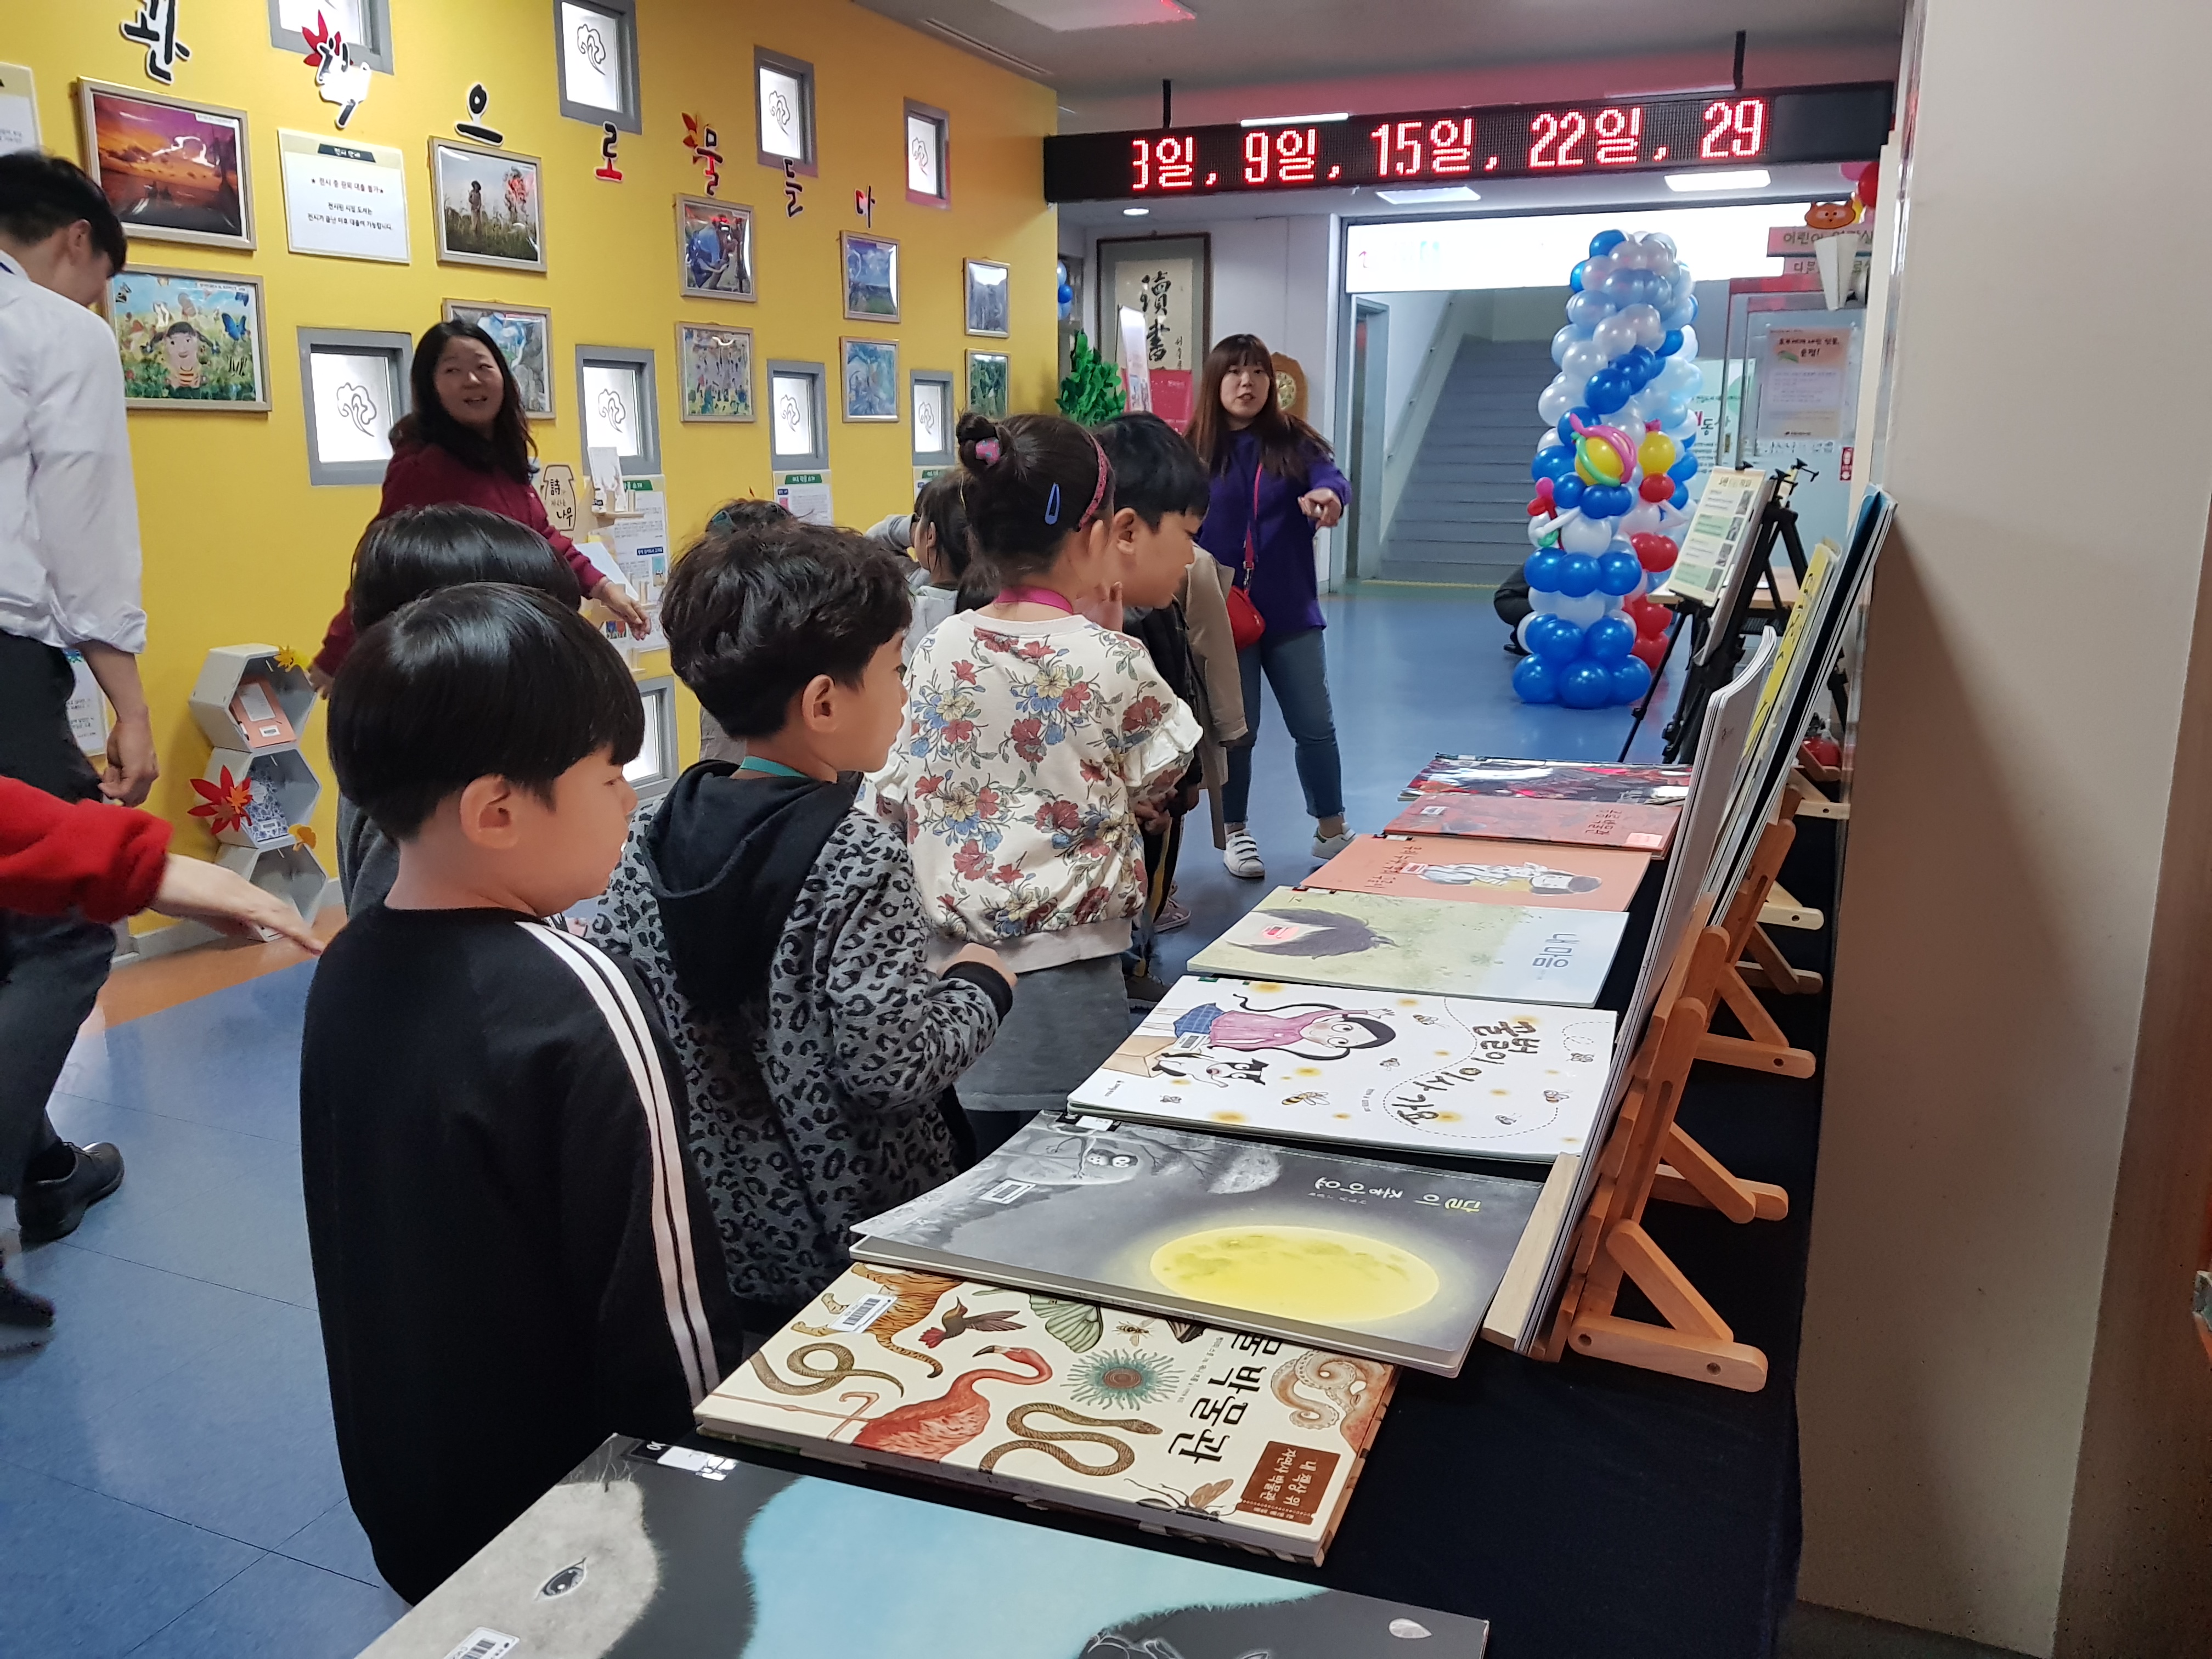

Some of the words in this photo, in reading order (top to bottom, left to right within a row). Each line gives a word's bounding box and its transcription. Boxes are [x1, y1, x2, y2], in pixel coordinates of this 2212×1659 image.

[1244, 128, 1341, 183] 9일,
[1371, 117, 1497, 177] 15일,
[1528, 106, 1668, 168] 22일,
[1701, 98, 1765, 159] 29
[1532, 946, 1573, 968] 마음
[1471, 1020, 1542, 1065] 꿀벌이
[1412, 1068, 1483, 1091] 이사
[1391, 1094, 1440, 1125] 가요
[1314, 1176, 1403, 1199] 좋아요
[1413, 1193, 1481, 1213] 달이
[1168, 1365, 1267, 1464] 박물관
[1274, 1448, 1297, 1474] 자연사
[1299, 1460, 1317, 1472] 내
[1260, 1474, 1285, 1503] 박물관
[1288, 1472, 1312, 1494] 책상
[1283, 1494, 1301, 1507] 위
